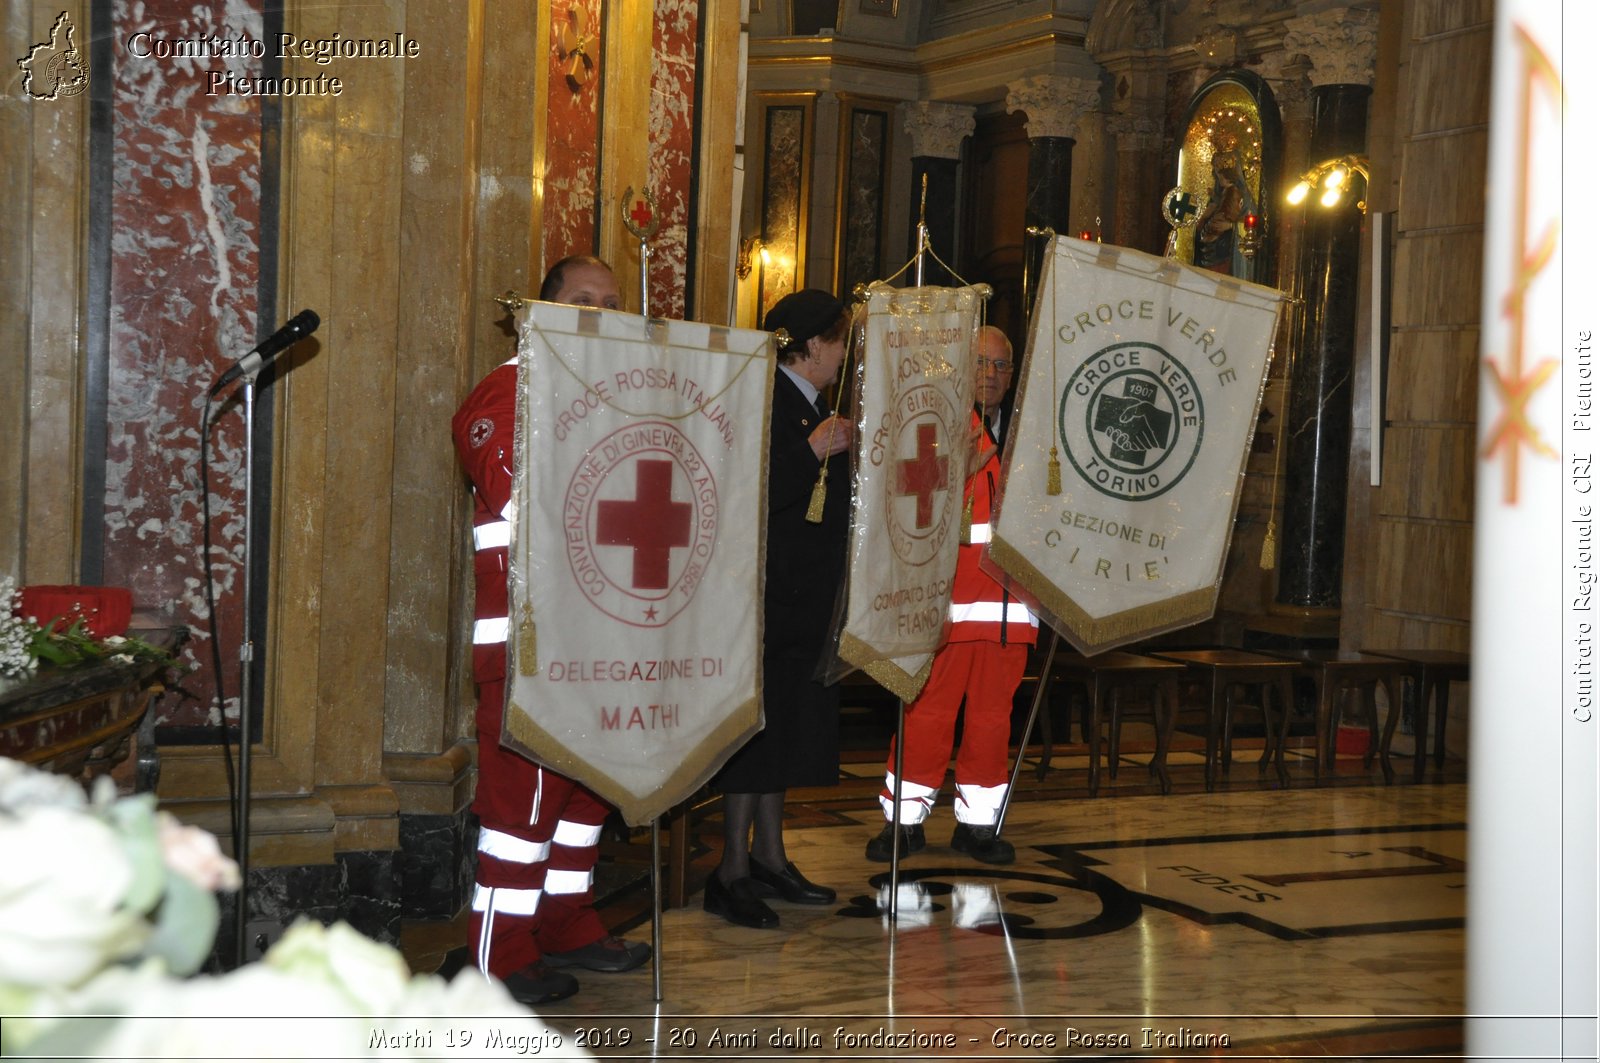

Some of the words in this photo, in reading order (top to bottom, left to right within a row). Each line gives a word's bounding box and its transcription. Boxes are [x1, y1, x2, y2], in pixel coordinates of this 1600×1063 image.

[1058, 299, 1154, 344] CROCE
[1166, 307, 1237, 387] VERDE
[1074, 351, 1141, 396] CROCE
[1159, 360, 1197, 427] VERDE
[1129, 383, 1155, 398] 1907
[554, 381, 613, 443] CROCE
[615, 367, 678, 393] ROSSA
[681, 378, 736, 451] ITALIANA
[602, 442, 622, 463] DI
[622, 428, 685, 459] GINEVRA
[684, 452, 701, 476] 22
[1085, 457, 1160, 493] TORINO
[567, 456, 606, 597] CONVENZIONE
[695, 476, 716, 558] AGOSTO
[1060, 510, 1143, 544] SEZIONE
[1148, 532, 1166, 551] DI
[680, 562, 700, 597] 1864
[873, 586, 924, 612] COMITATO
[897, 606, 940, 637] FIANO
[549, 659, 693, 682] DELEGAZIONE
[702, 657, 722, 677] DI
[601, 704, 679, 731] MATHI
[1157, 864, 1283, 903] FIDES
